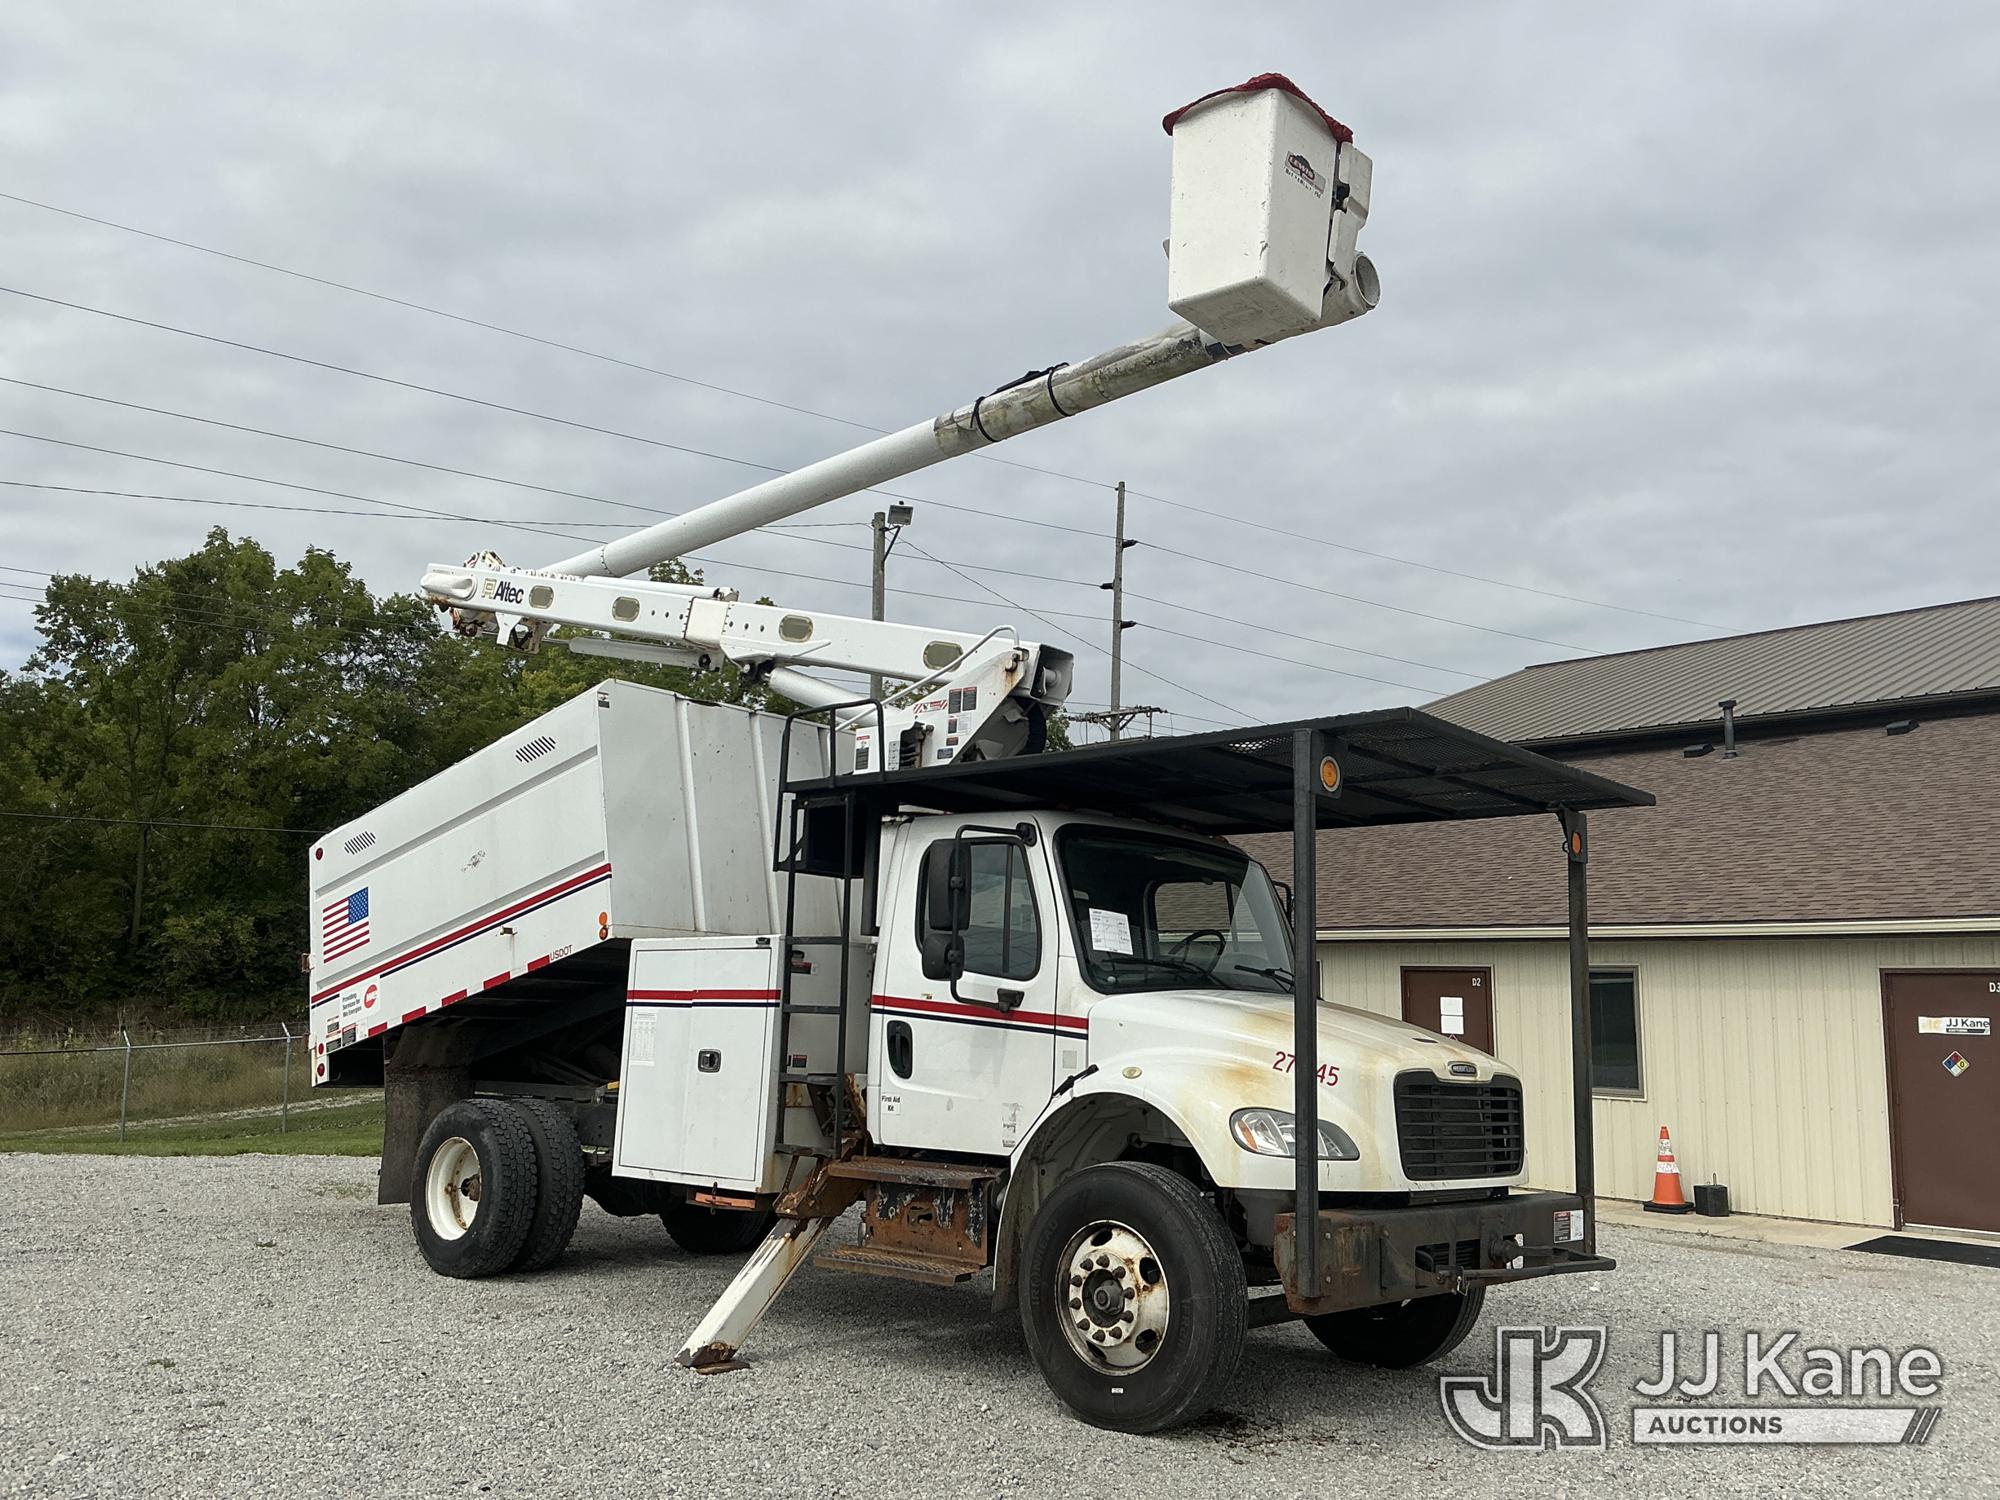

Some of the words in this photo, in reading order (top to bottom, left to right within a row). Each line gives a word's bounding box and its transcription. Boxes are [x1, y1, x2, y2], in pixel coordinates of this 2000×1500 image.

[493, 580, 525, 604] Altec
[550, 944, 572, 961] USDOT
[1472, 977, 1481, 987] D2
[1946, 1018, 1959, 1028] JJ
[1961, 1018, 1989, 1028] Kane
[1272, 1050, 1340, 1087] 2745
